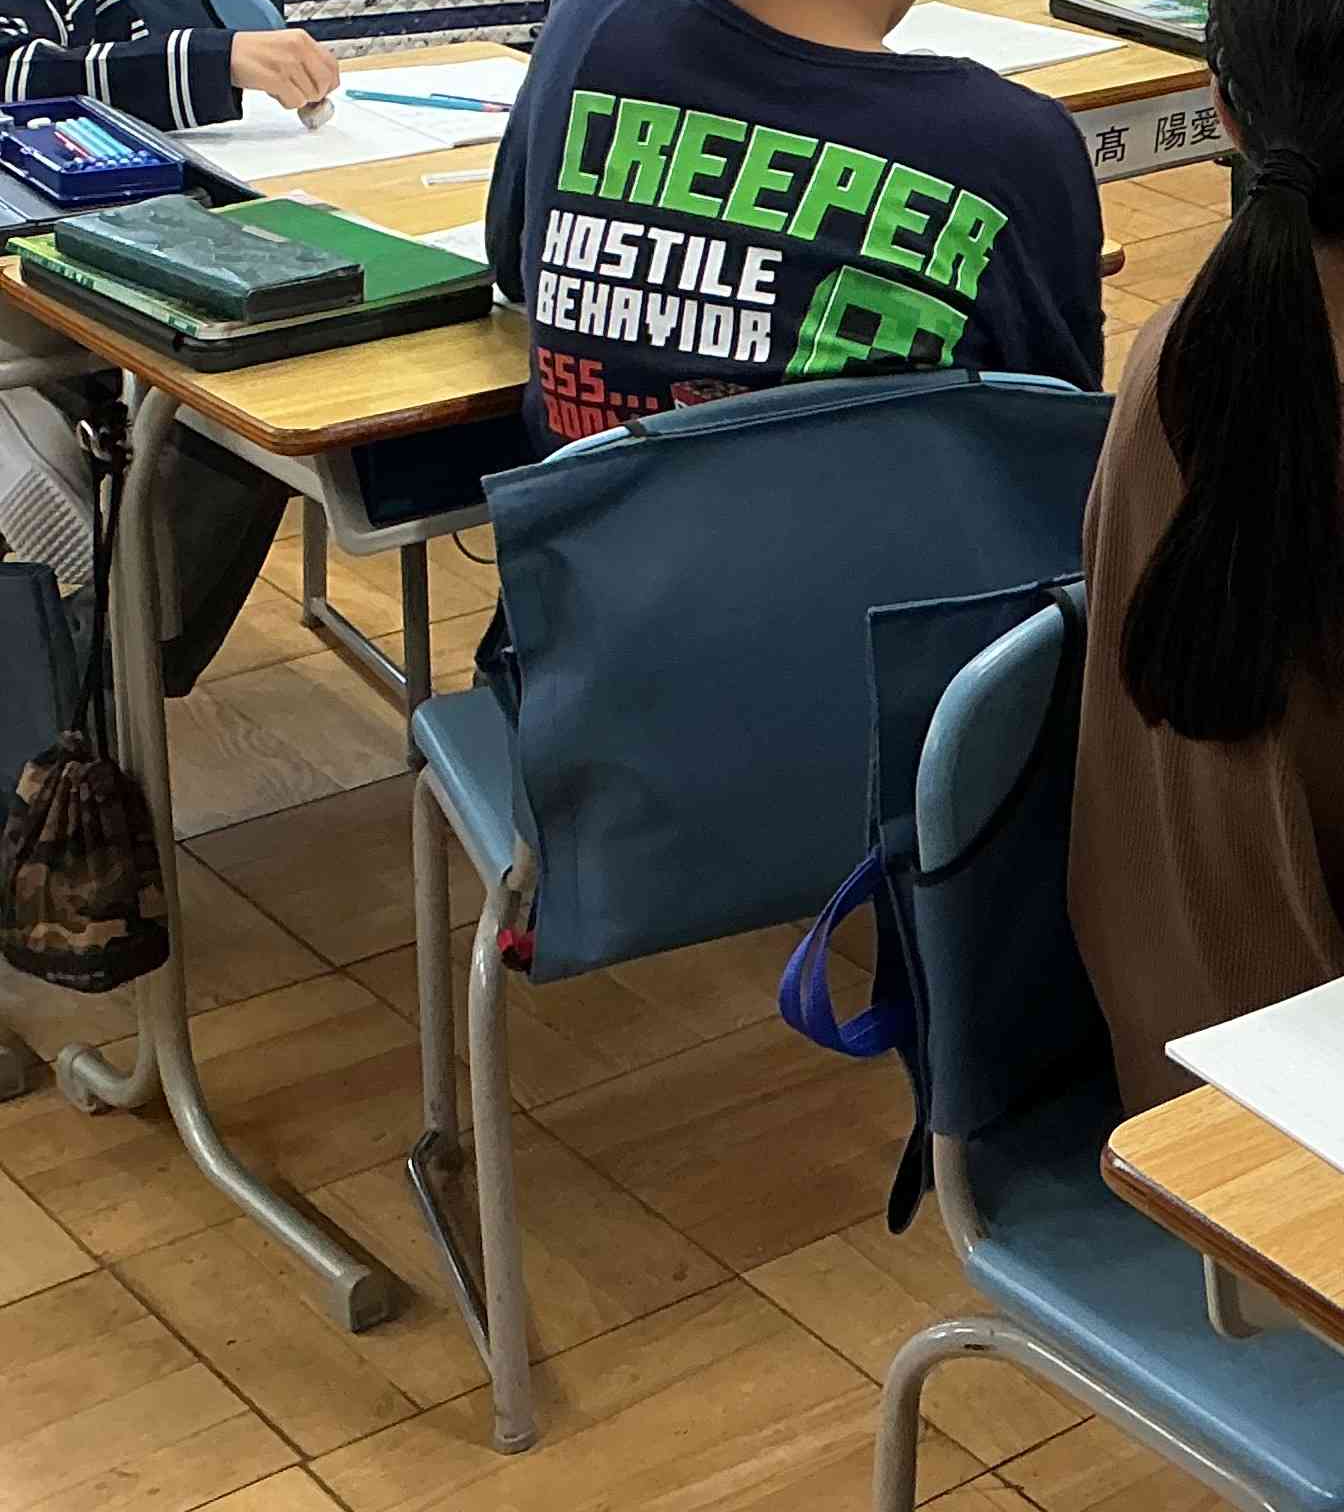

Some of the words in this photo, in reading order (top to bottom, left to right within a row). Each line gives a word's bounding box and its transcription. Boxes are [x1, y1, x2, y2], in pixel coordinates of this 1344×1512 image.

[557, 89, 1008, 301] CREEPER
[542, 209, 783, 305] HOSTILE
[535, 270, 772, 363] BEHAVIOR
